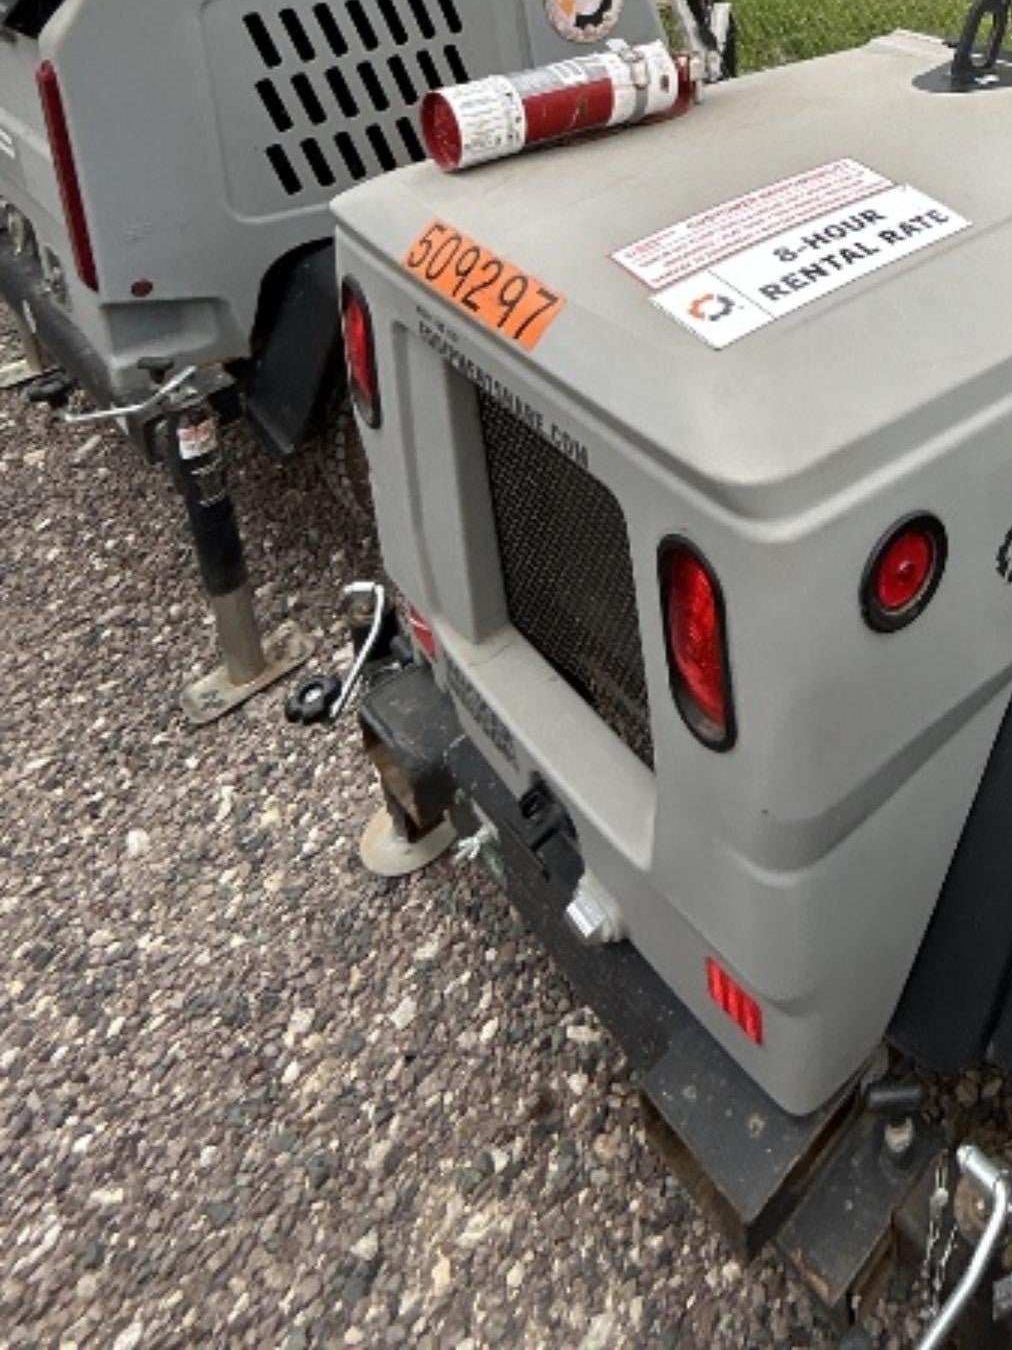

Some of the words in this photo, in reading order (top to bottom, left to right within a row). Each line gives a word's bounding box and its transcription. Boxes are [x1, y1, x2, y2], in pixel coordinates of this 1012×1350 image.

[406, 222, 560, 341] 509297
[757, 237, 880, 301] RENTAL
[884, 207, 950, 246] RATE
[772, 207, 886, 264] 8-HOUR
